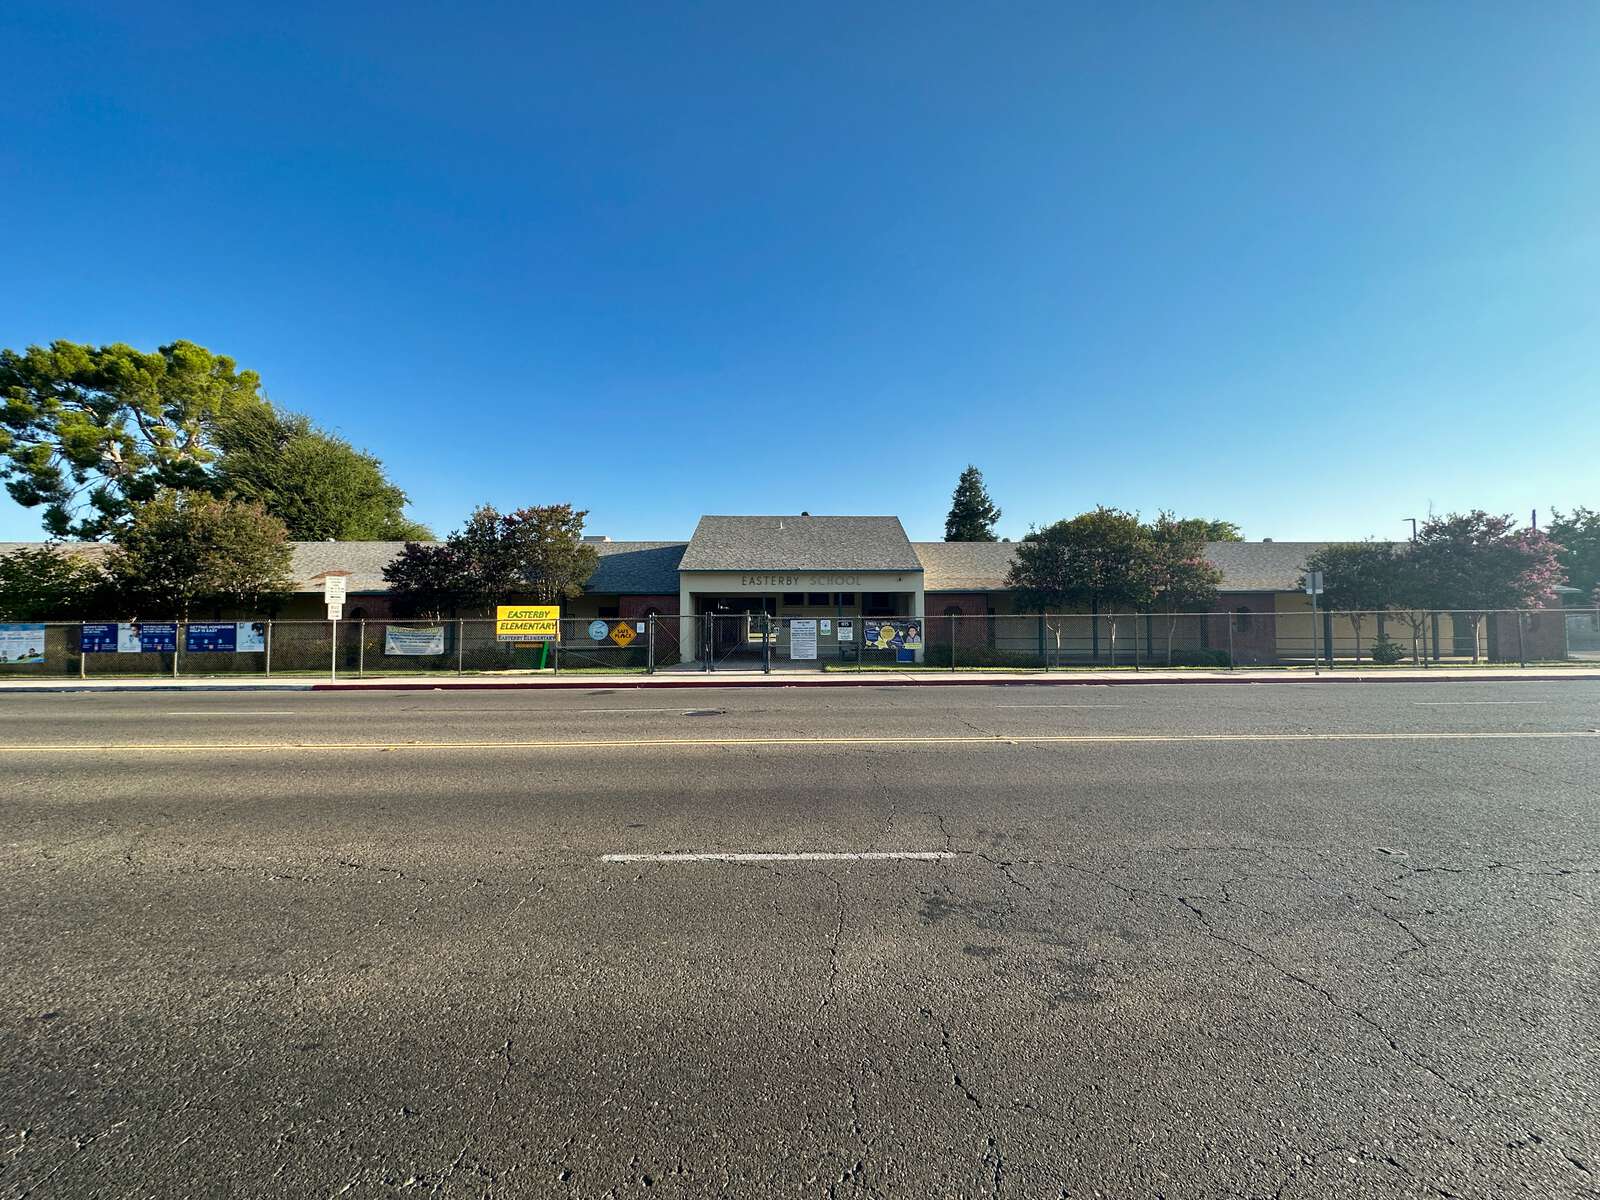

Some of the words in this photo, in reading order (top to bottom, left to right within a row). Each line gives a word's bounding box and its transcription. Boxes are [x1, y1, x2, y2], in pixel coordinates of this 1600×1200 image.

[741, 575, 800, 586] EASTERBY
[809, 575, 862, 586] SCHOOL
[507, 610, 551, 619] EASTERBY
[500, 622, 557, 630] ELEMENTARY
